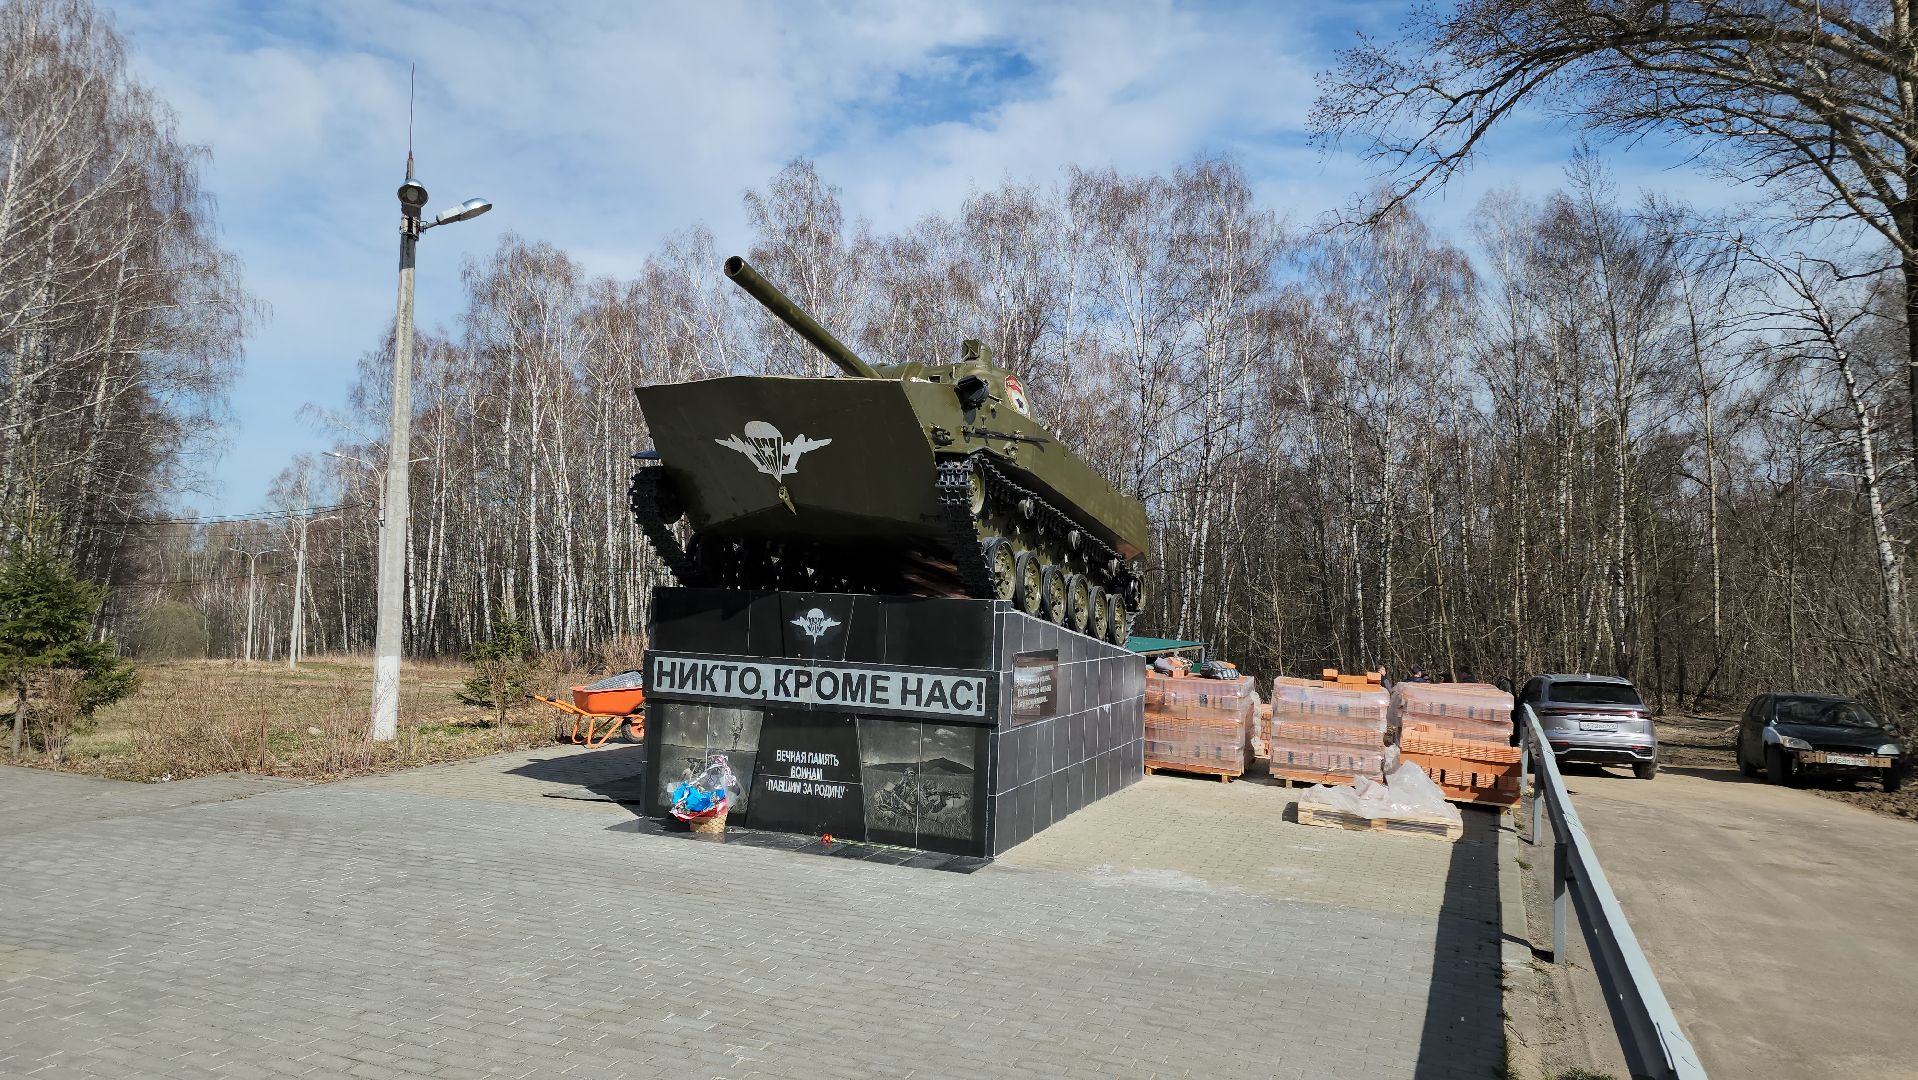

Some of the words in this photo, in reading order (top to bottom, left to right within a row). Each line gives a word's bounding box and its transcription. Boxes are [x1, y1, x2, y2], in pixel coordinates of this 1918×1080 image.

[656, 660, 768, 700] НИКТО,
[773, 668, 890, 705] КРОМЕ
[900, 676, 984, 712] НАС!
[776, 750, 807, 763] ВЕЧНАЯ
[807, 752, 840, 767] ПАМЯТЬ
[790, 766, 823, 781] ВОИНАМ
[768, 779, 802, 794] ПАВШИМ
[803, 782, 813, 795] ЗА
[814, 784, 846, 799] РОДИНУ
